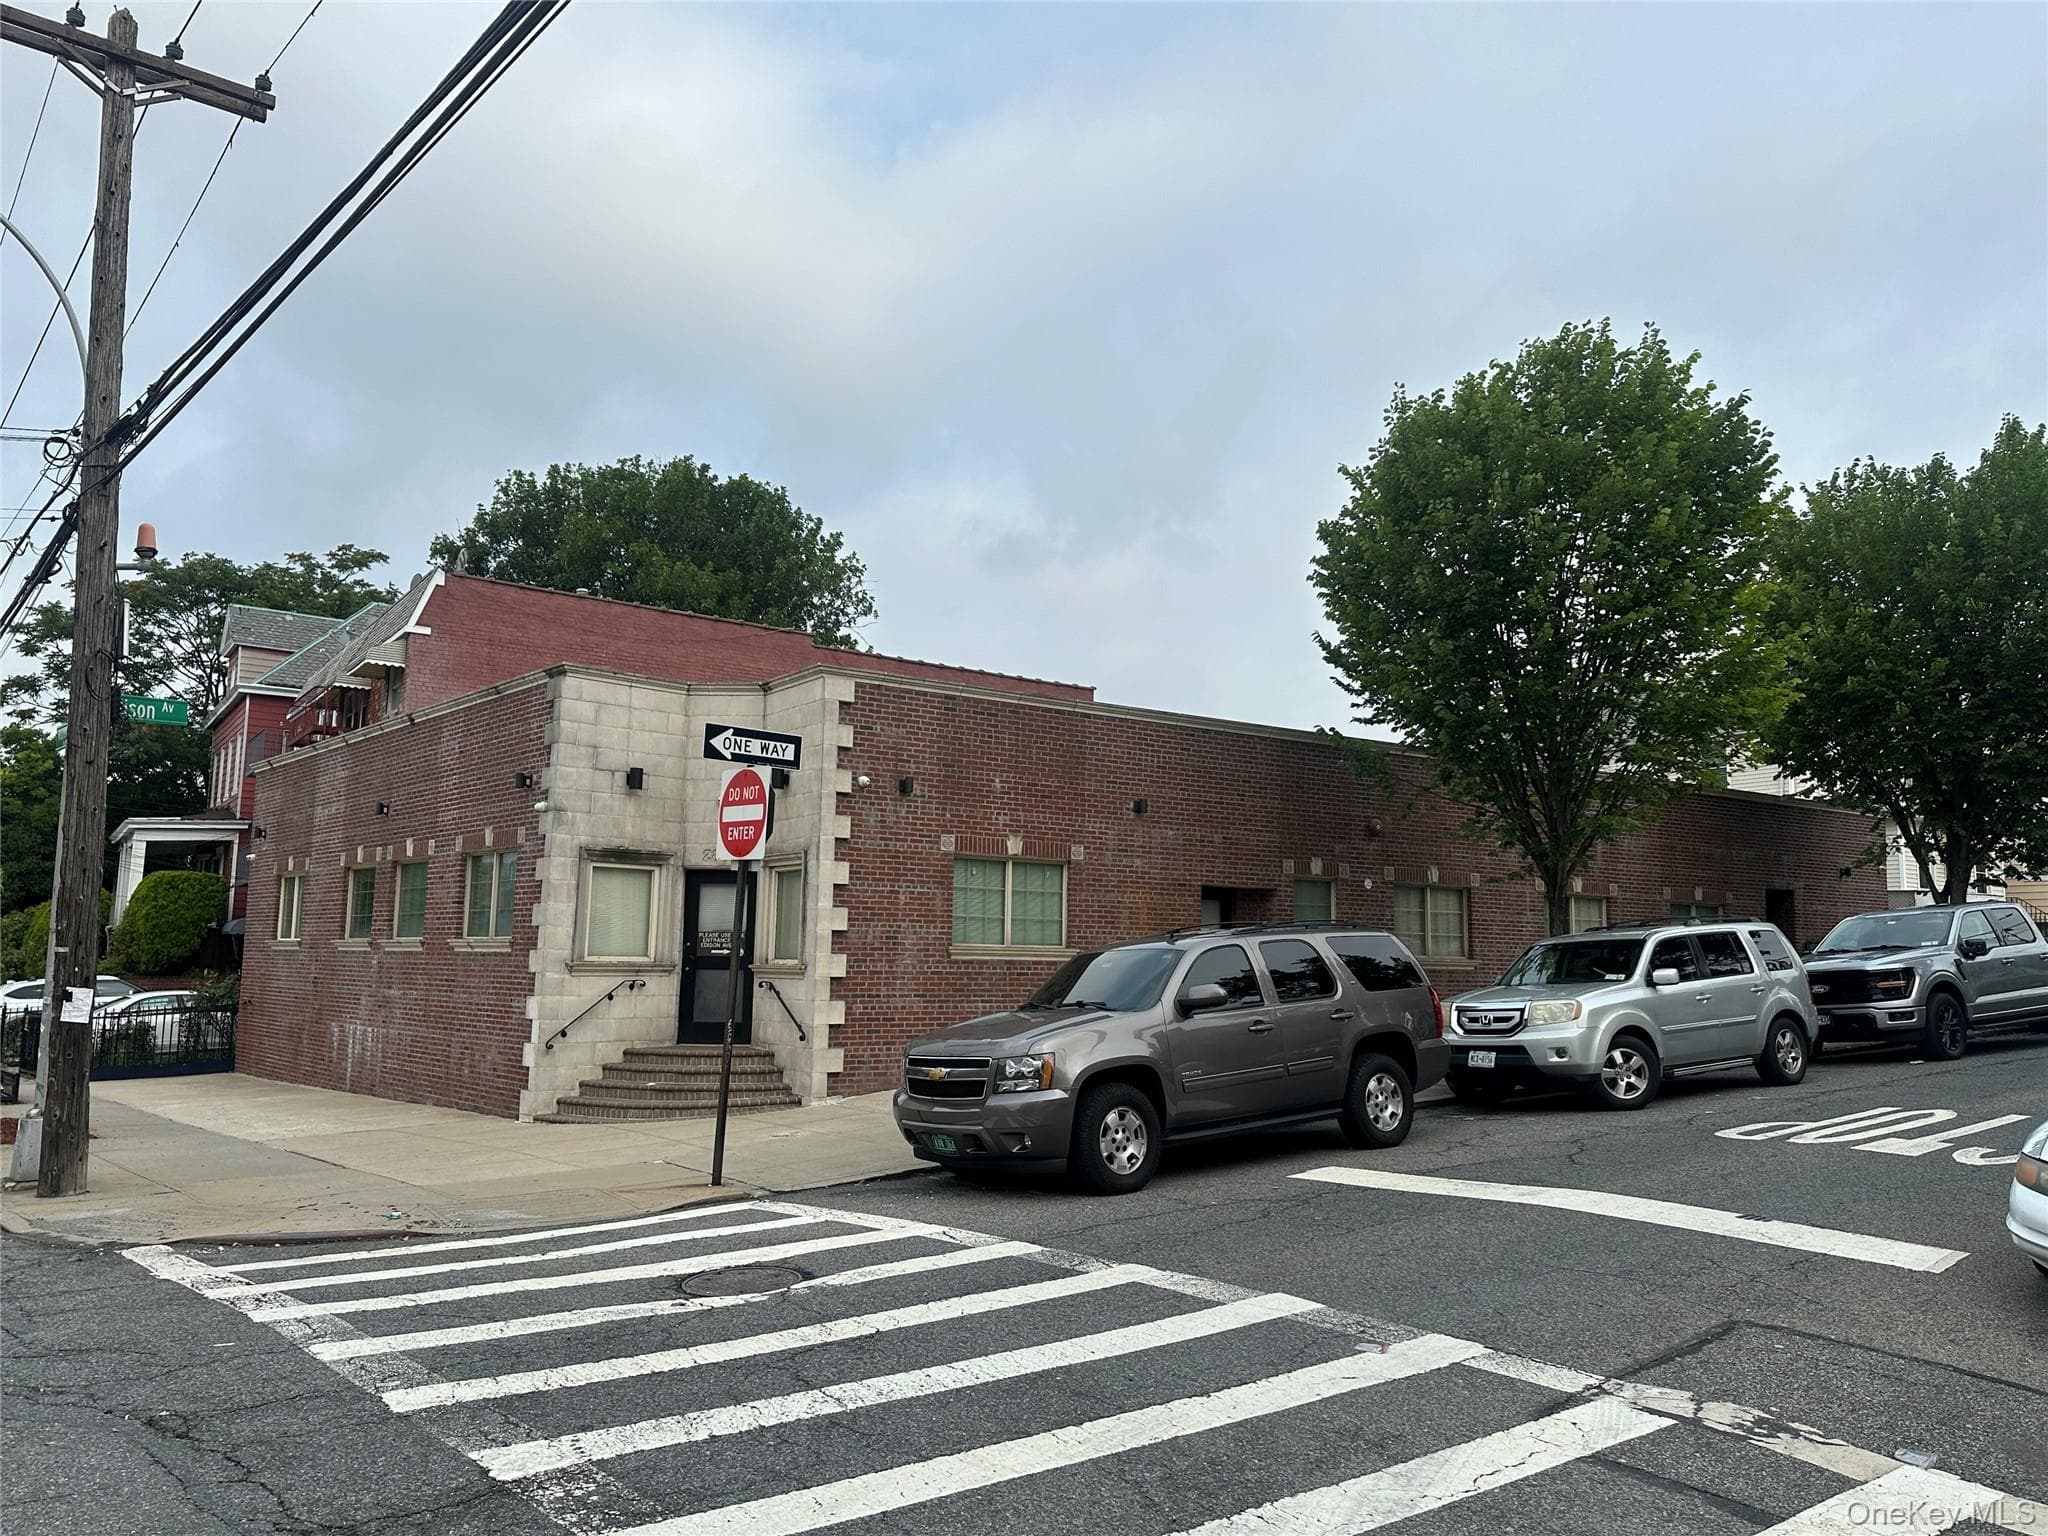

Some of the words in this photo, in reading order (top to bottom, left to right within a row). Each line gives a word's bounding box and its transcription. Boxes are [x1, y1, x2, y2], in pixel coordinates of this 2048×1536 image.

[161, 701, 175, 713] Av
[723, 737, 752, 753] ONE
[760, 741, 788, 758] WAY
[728, 787, 740, 801] DO
[742, 785, 760, 800] NOT
[727, 826, 755, 841] ENTER
